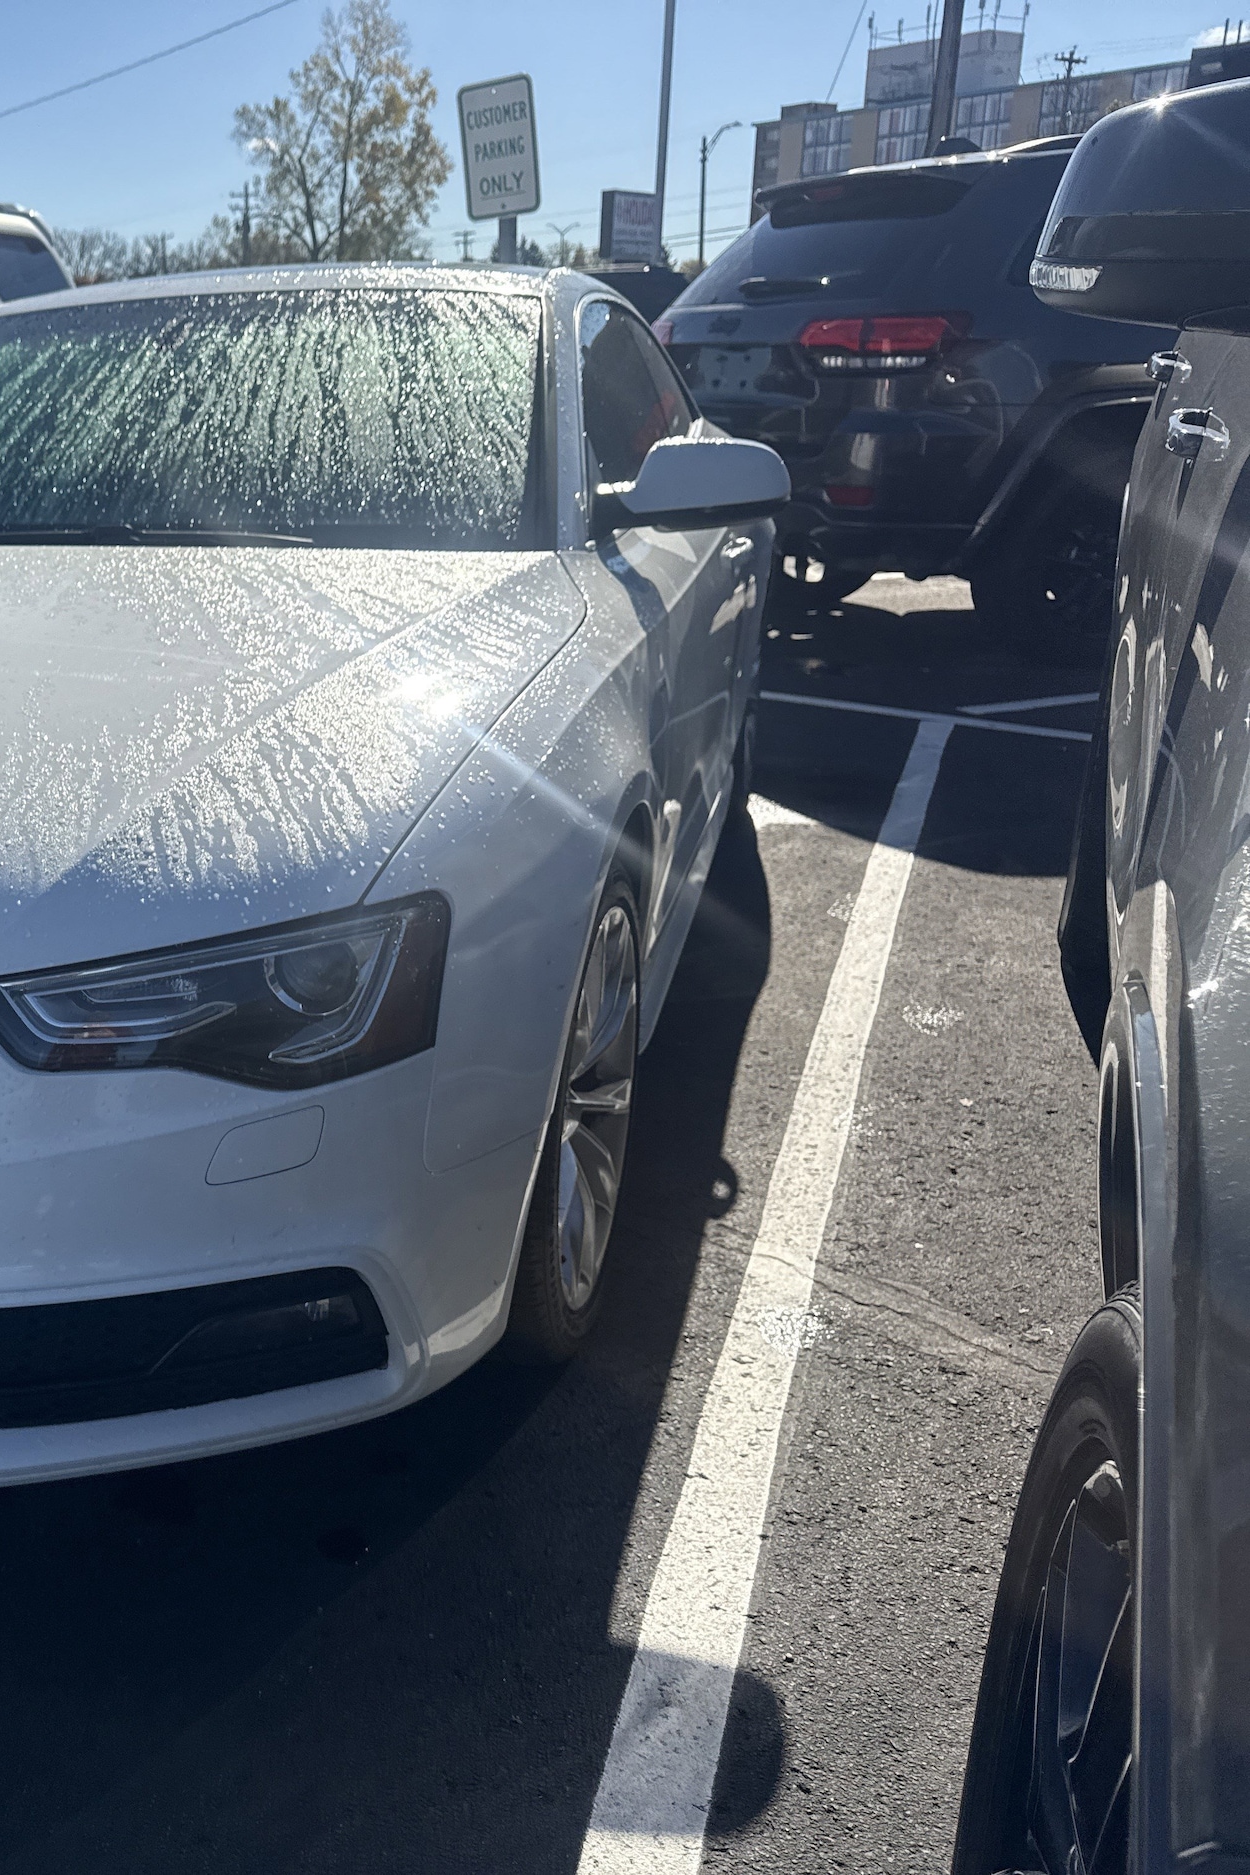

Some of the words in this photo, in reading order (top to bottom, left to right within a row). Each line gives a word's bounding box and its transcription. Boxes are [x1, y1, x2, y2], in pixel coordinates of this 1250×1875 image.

[466, 101, 527, 130] CUSTOMER
[474, 135, 525, 162] PARKING
[479, 170, 524, 195] ONLY
